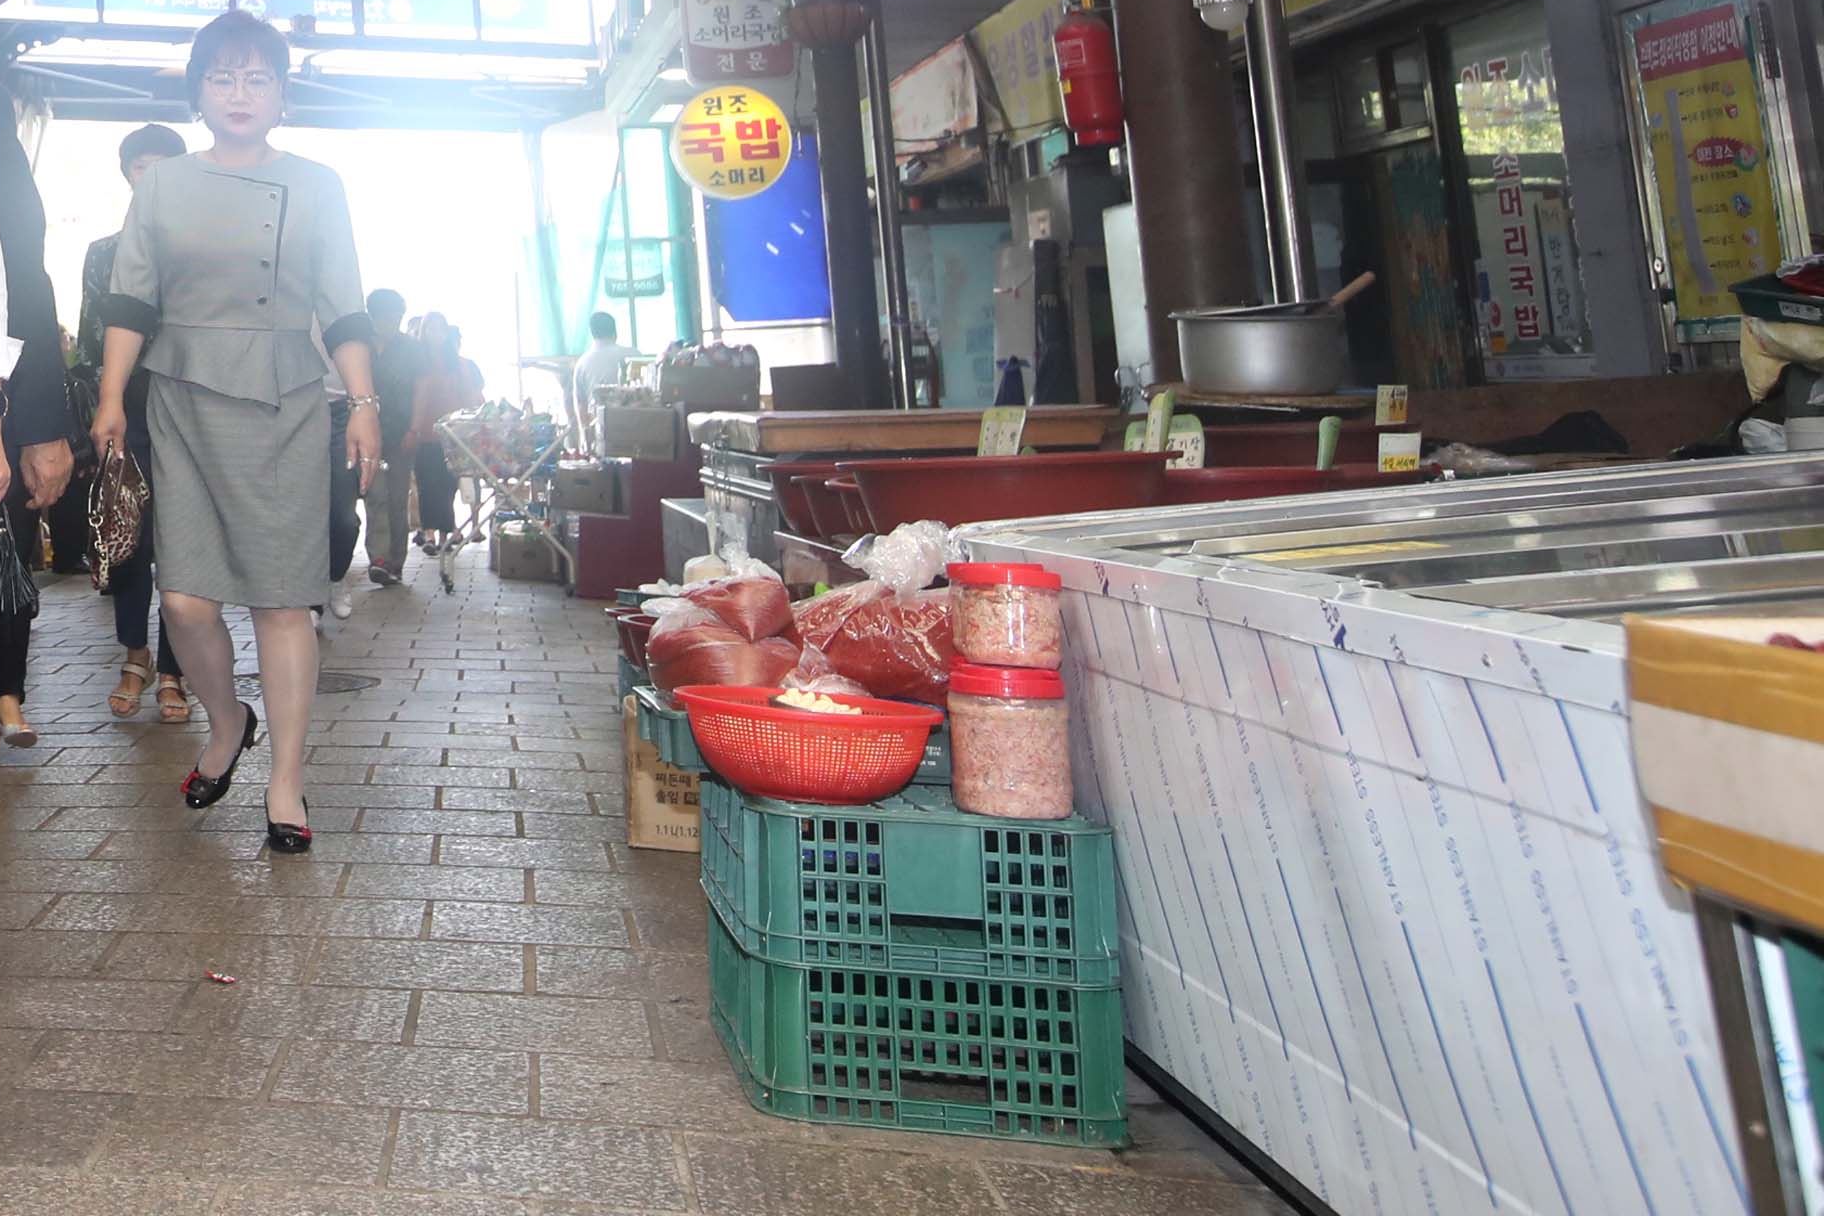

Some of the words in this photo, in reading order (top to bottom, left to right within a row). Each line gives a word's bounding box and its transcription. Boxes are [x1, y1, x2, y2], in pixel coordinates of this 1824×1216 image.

[703, 93, 749, 116] 원조
[681, 118, 782, 163] 국밥
[709, 166, 765, 186] 소머리
[1247, 762, 1278, 852] STAINLESS
[1363, 809, 1404, 913] STAINLESS
[1444, 837, 1487, 951] STAINLESS
